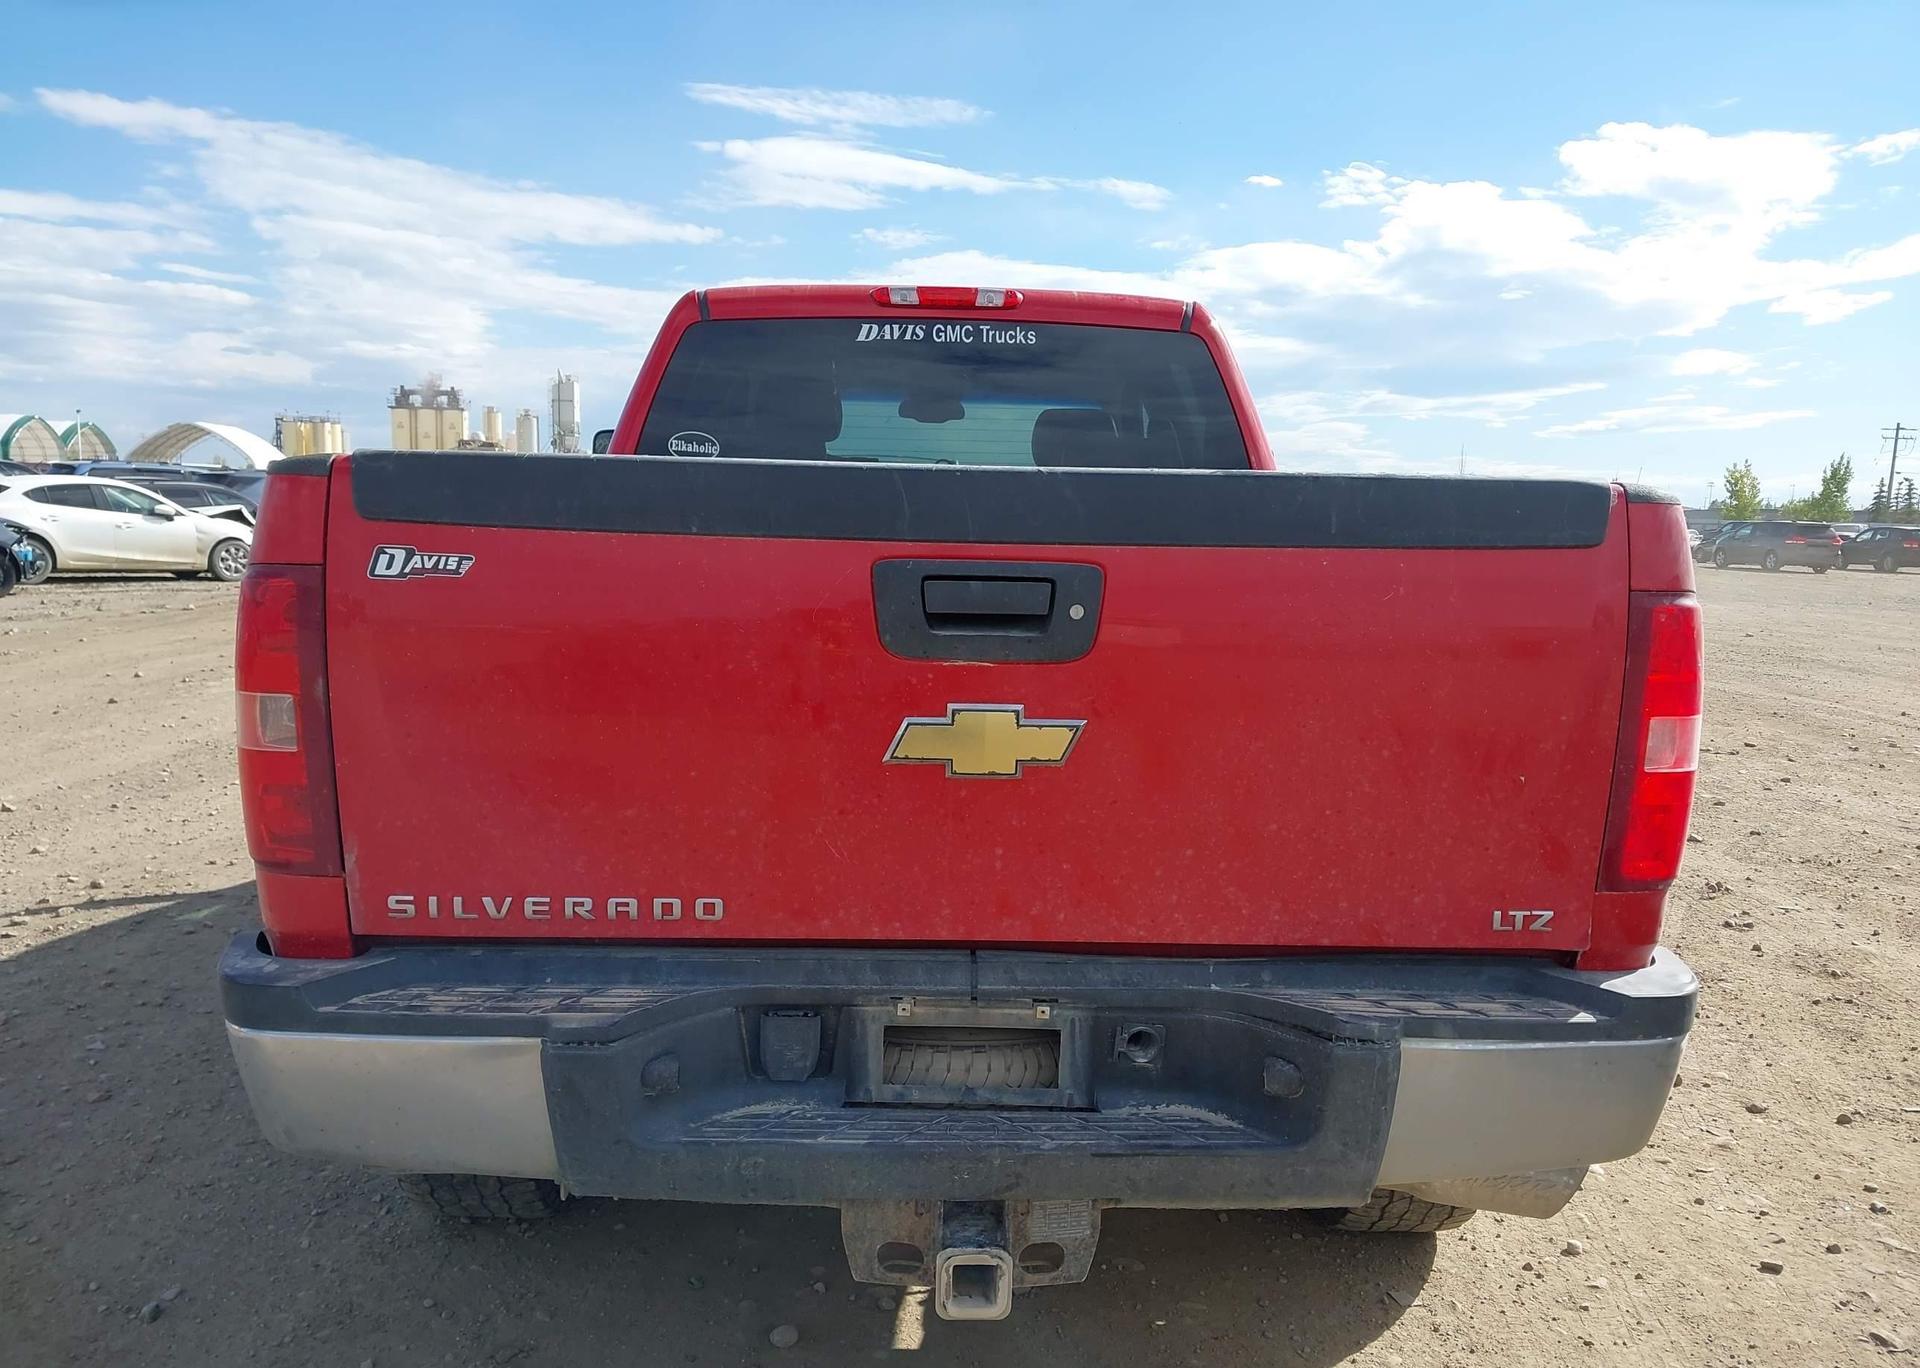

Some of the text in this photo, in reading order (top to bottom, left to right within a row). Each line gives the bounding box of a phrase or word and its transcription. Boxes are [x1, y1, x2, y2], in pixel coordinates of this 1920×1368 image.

[856, 323, 1036, 344] DAVIS GMC Trucks
[671, 440, 717, 454] Elkaholic
[374, 548, 459, 576] DAVIS
[387, 895, 725, 920] SILVERADO
[1492, 910, 1554, 931] LTZ
